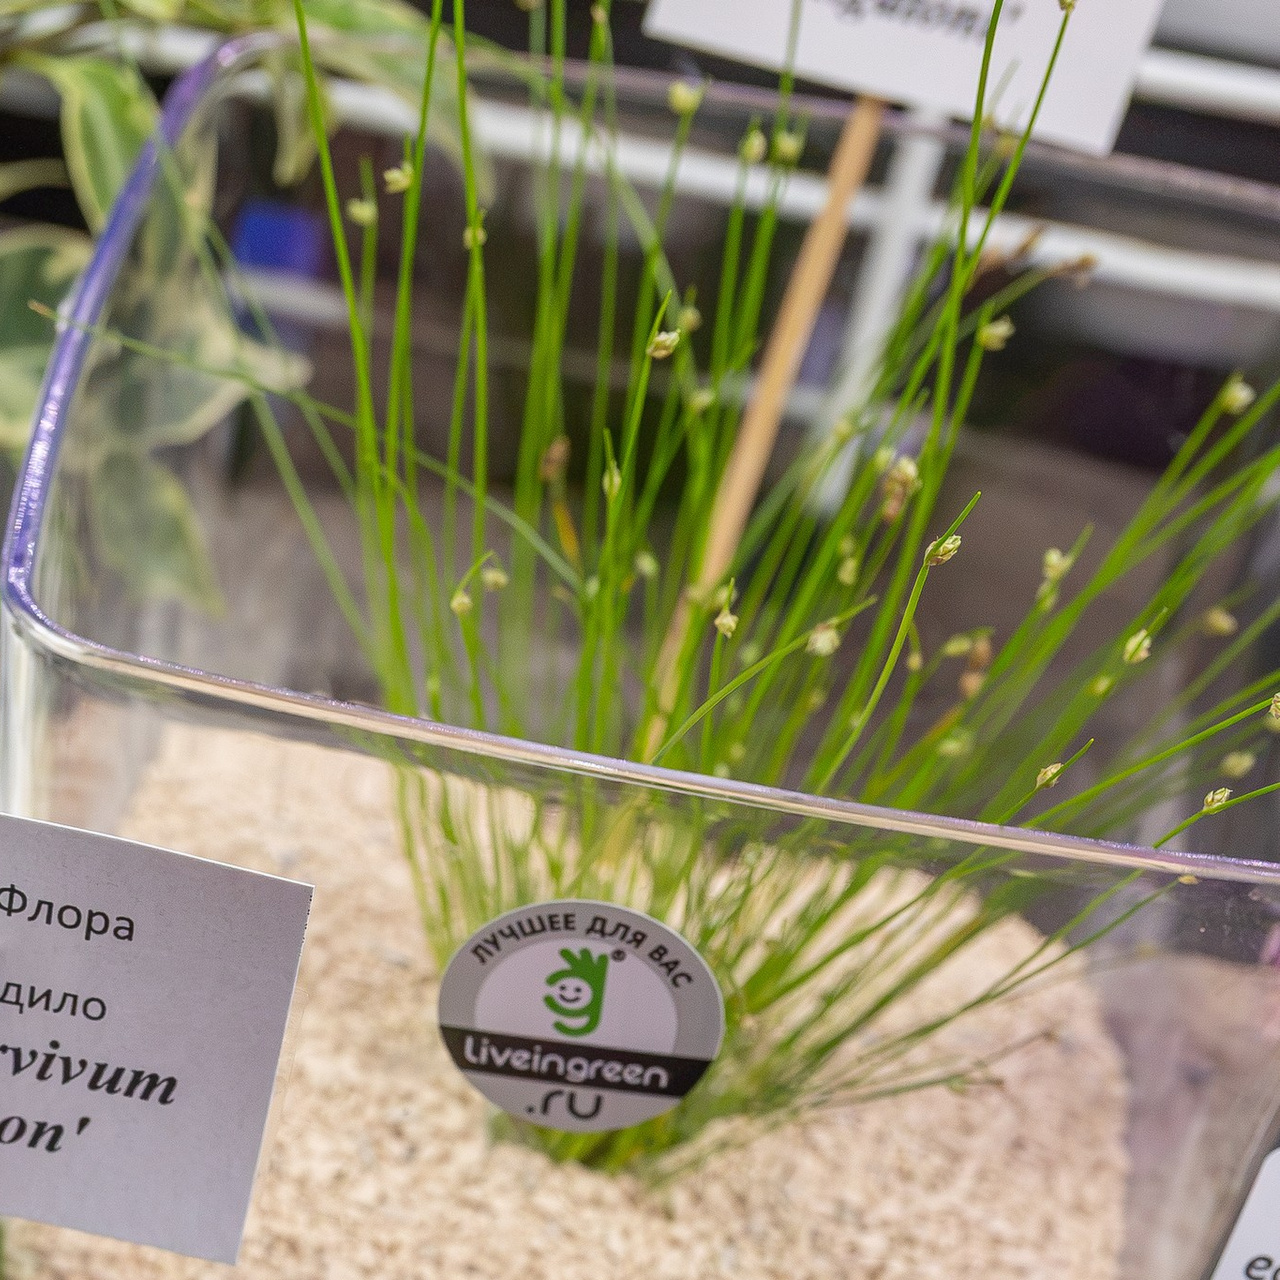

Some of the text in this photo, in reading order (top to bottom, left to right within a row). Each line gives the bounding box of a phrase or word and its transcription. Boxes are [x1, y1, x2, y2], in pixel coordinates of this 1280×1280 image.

[471, 913, 694, 988] ЛУЧШЕЕ ДЛЯ ВАС
